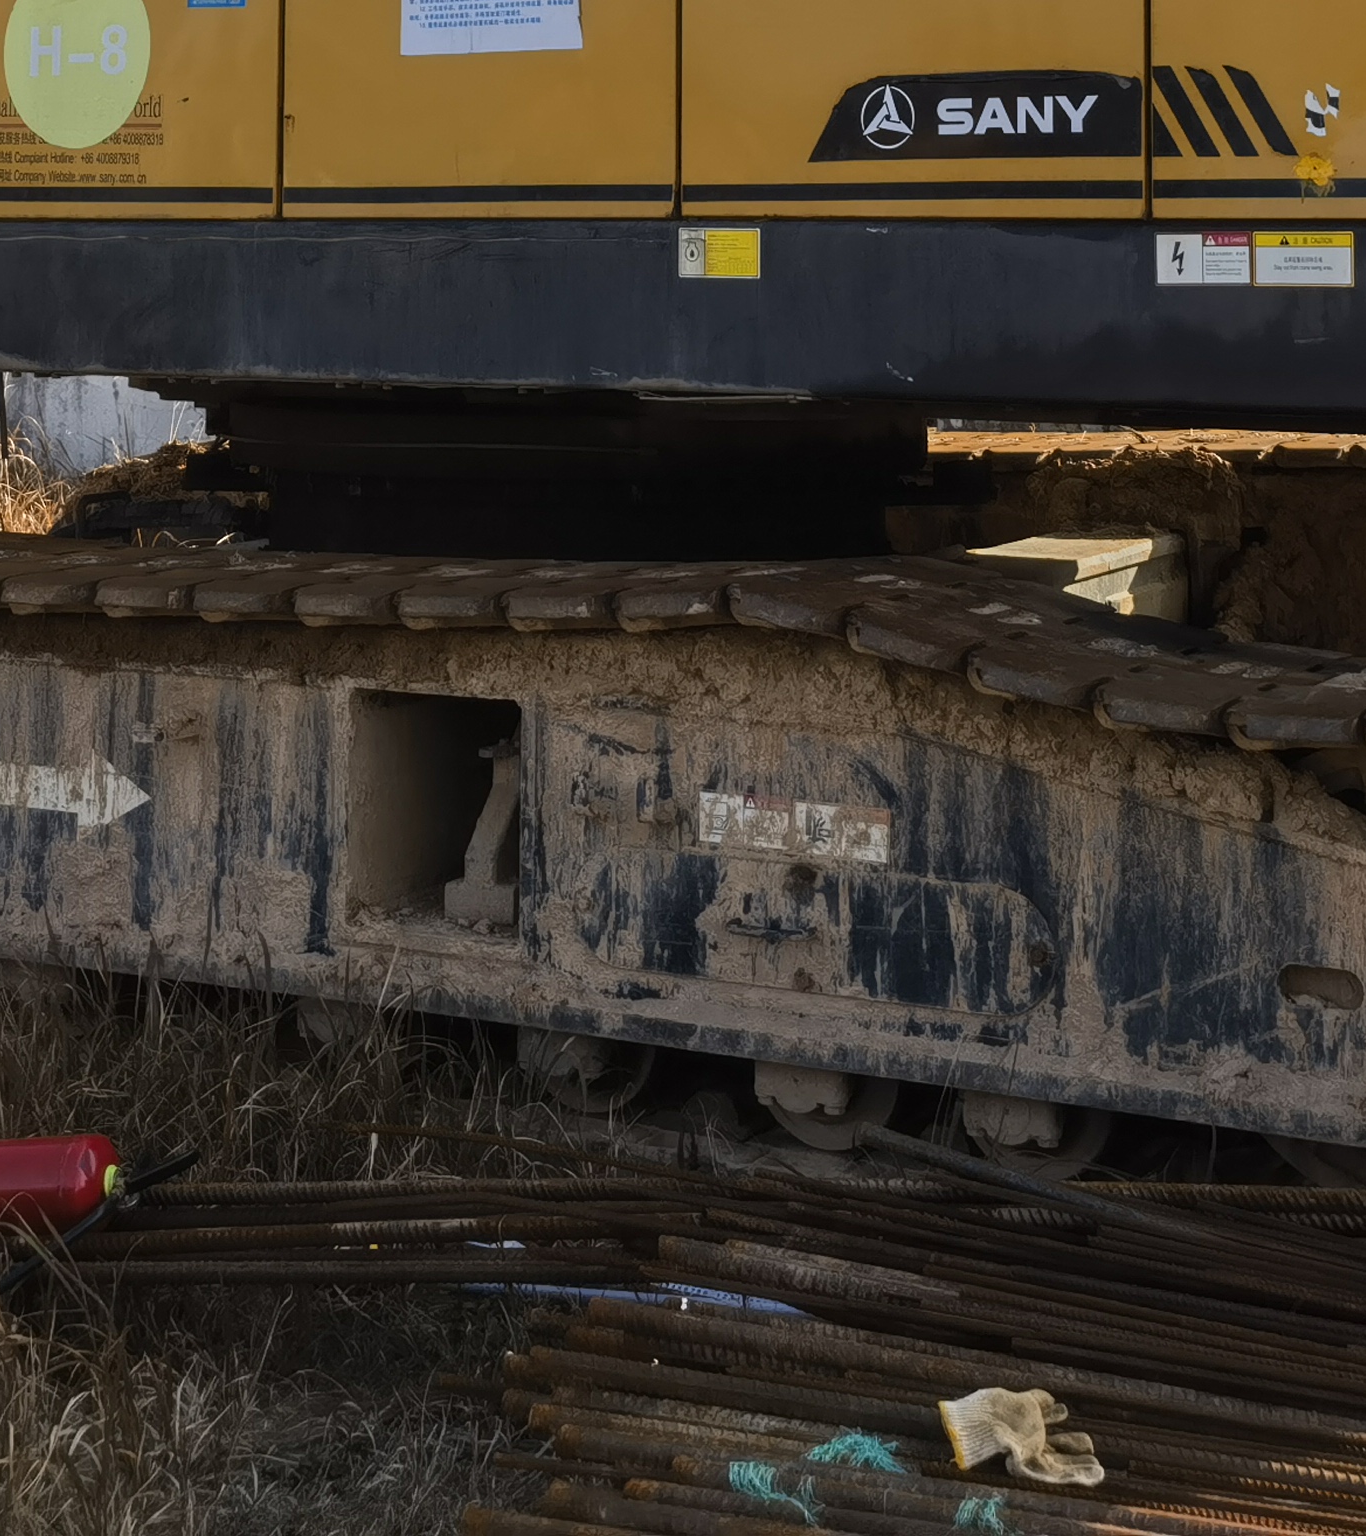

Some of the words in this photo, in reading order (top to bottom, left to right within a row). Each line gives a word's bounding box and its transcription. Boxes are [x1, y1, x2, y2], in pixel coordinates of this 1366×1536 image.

[29, 24, 127, 77] H-8
[135, 96, 161, 118] orld
[937, 95, 1099, 135] SANY
[14, 151, 49, 165] Complaint
[14, 169, 47, 185] Company
